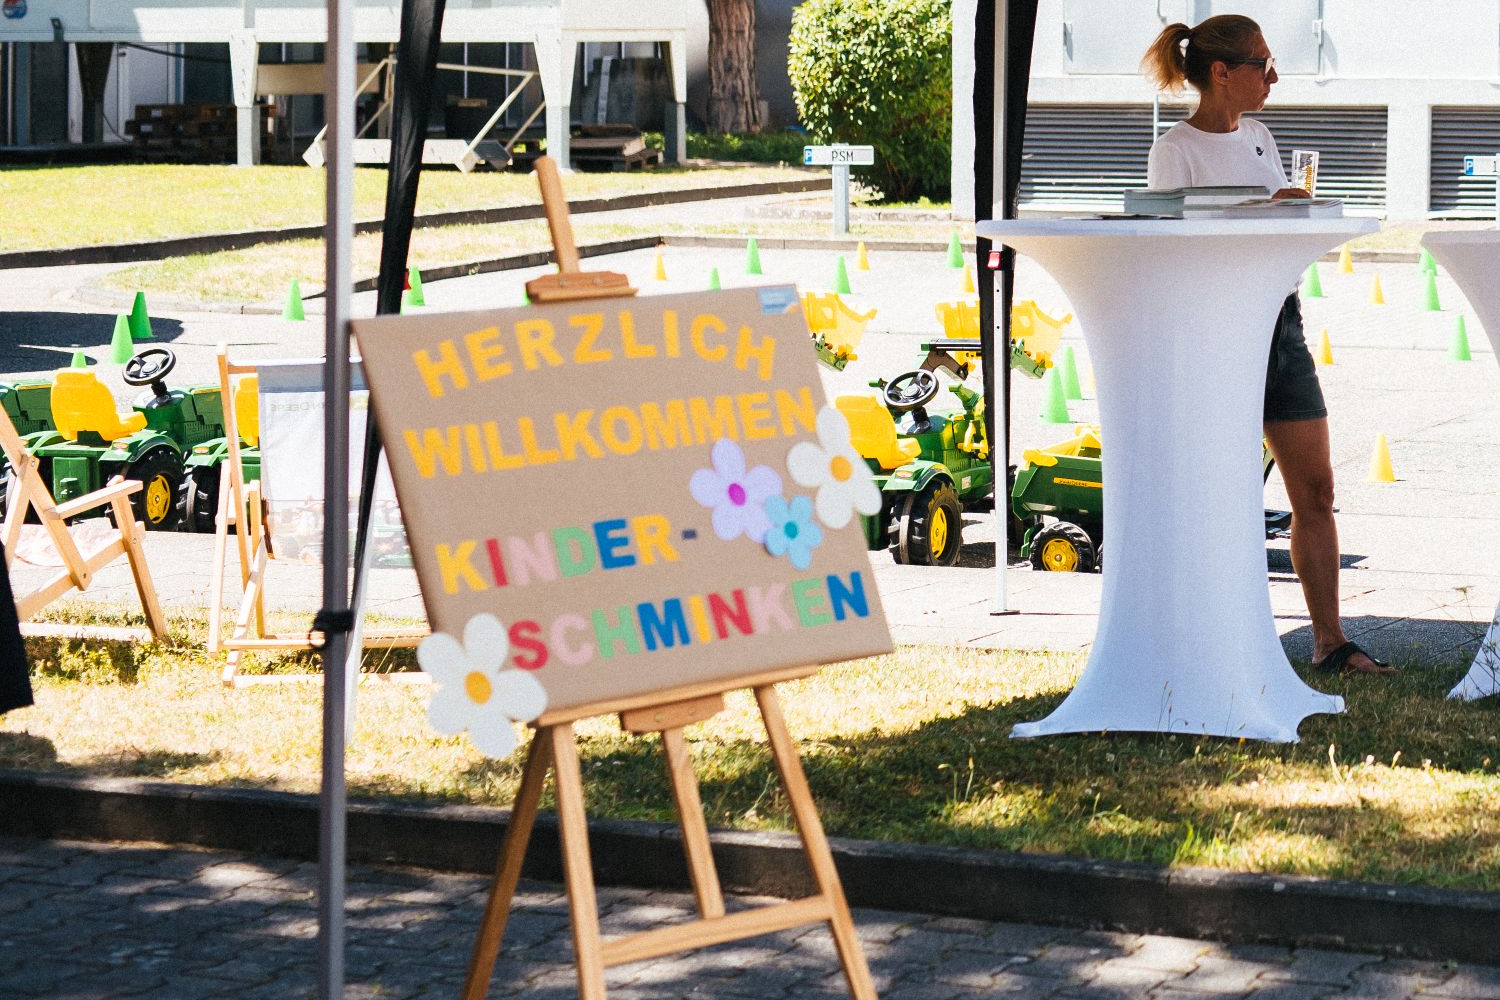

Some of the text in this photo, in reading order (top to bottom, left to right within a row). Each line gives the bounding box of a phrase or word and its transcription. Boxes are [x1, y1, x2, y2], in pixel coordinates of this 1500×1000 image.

[832, 150, 853, 162] PSM
[412, 309, 777, 397] HERZLICH
[402, 387, 817, 479] WILLKOMMEN
[436, 514, 698, 594] KINDER-
[508, 571, 869, 670] SCHMINKEN
